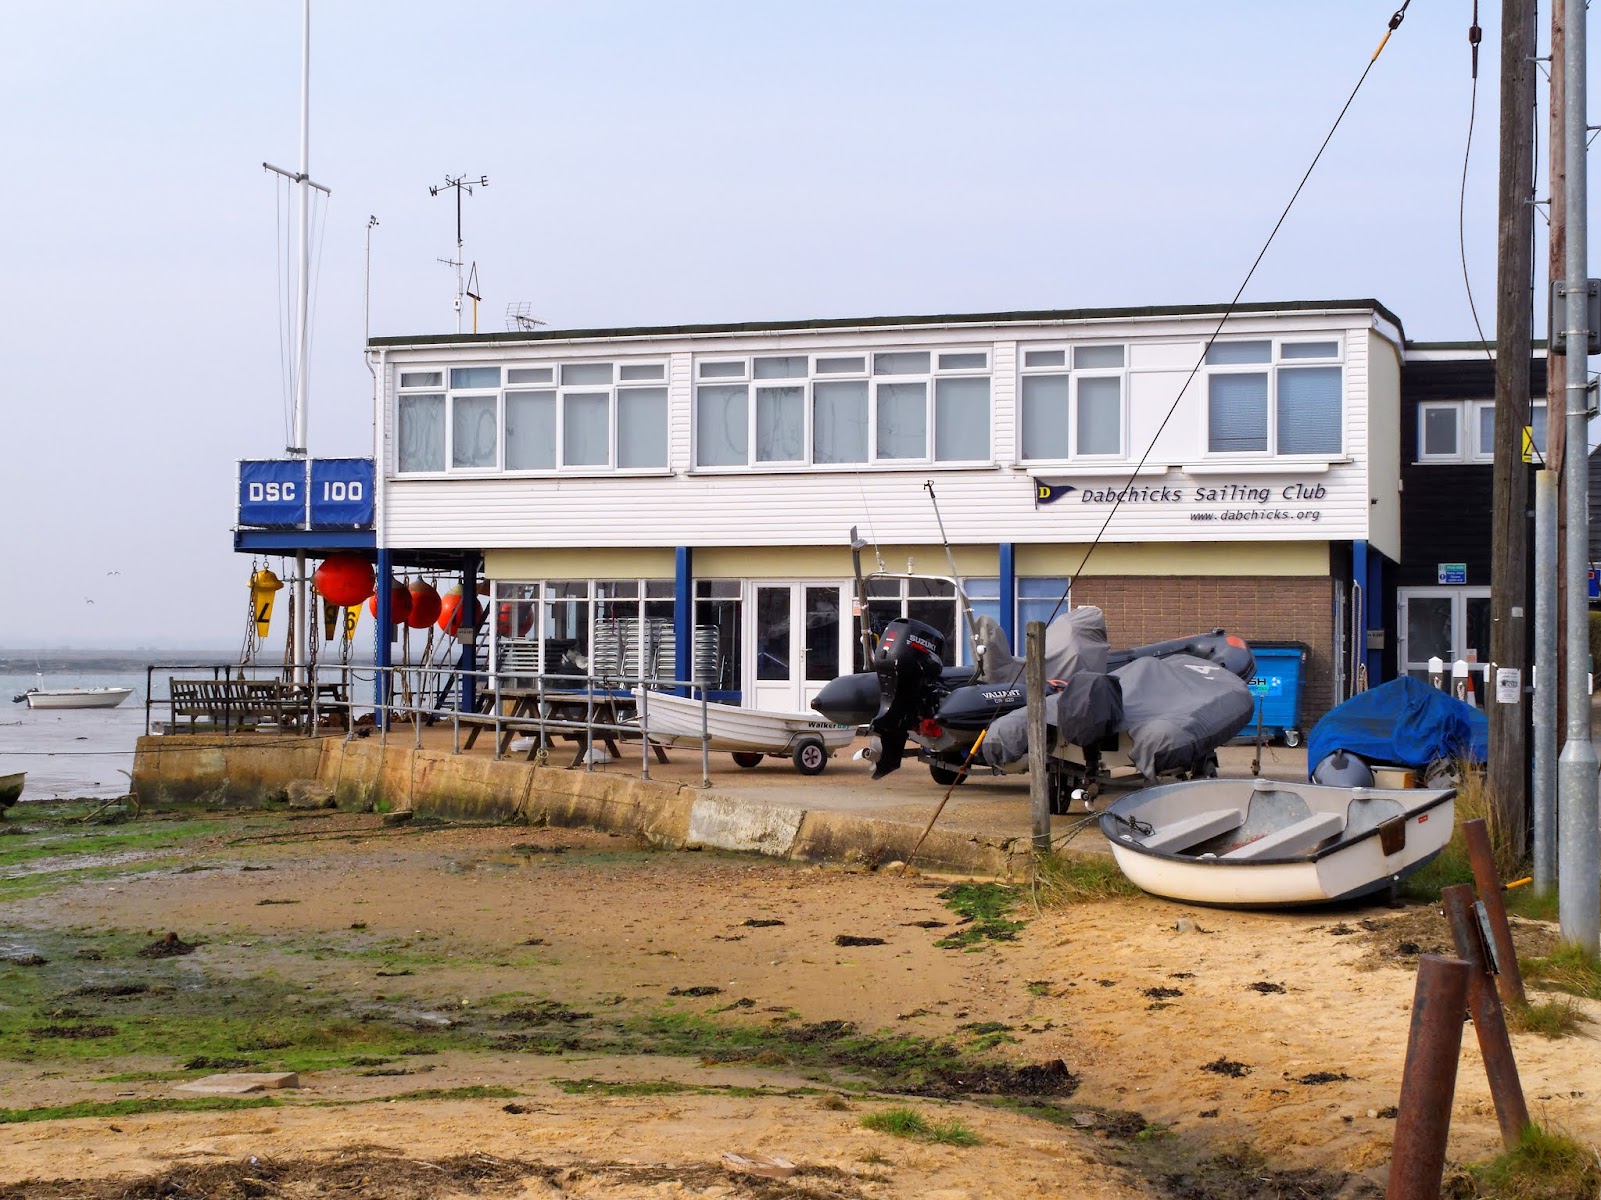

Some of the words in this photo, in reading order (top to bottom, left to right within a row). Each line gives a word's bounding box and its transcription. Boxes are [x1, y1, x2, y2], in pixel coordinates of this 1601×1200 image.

[480, 175, 489, 187] E
[429, 185, 438, 197] W
[249, 482, 295, 502] DSC
[323, 481, 363, 501] 100
[1038, 486, 1051, 499] D
[1081, 485, 1183, 503] Dabchicks
[1194, 484, 1271, 504] Sailing
[1282, 483, 1327, 501] Club
[1190, 509, 1320, 522] www.dabchicks.org
[909, 634, 937, 652] SUZUKI
[981, 689, 1021, 699] VALIANT
